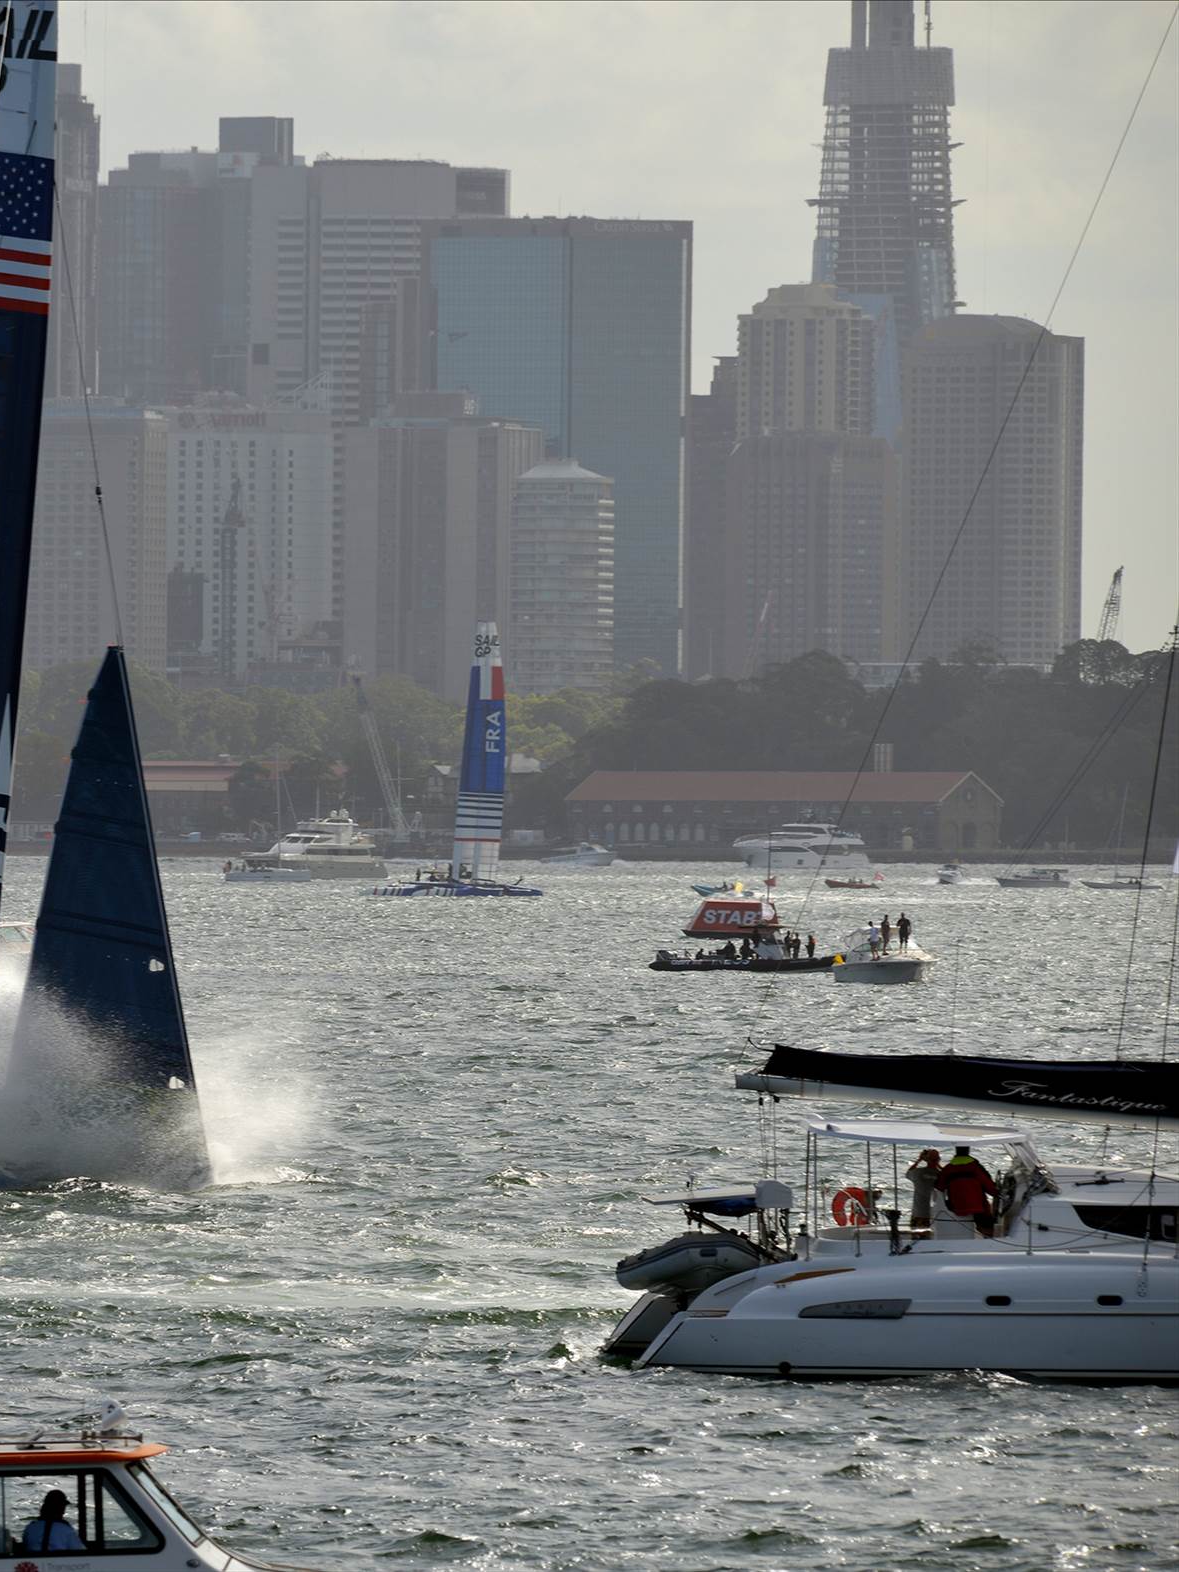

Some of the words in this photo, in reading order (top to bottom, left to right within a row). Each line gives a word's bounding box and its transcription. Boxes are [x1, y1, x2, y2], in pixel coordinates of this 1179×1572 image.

[474, 634, 500, 647] SAIL
[474, 646, 492, 658] GP
[485, 710, 501, 753] FRA
[987, 1079, 1171, 1112] Fantastique
